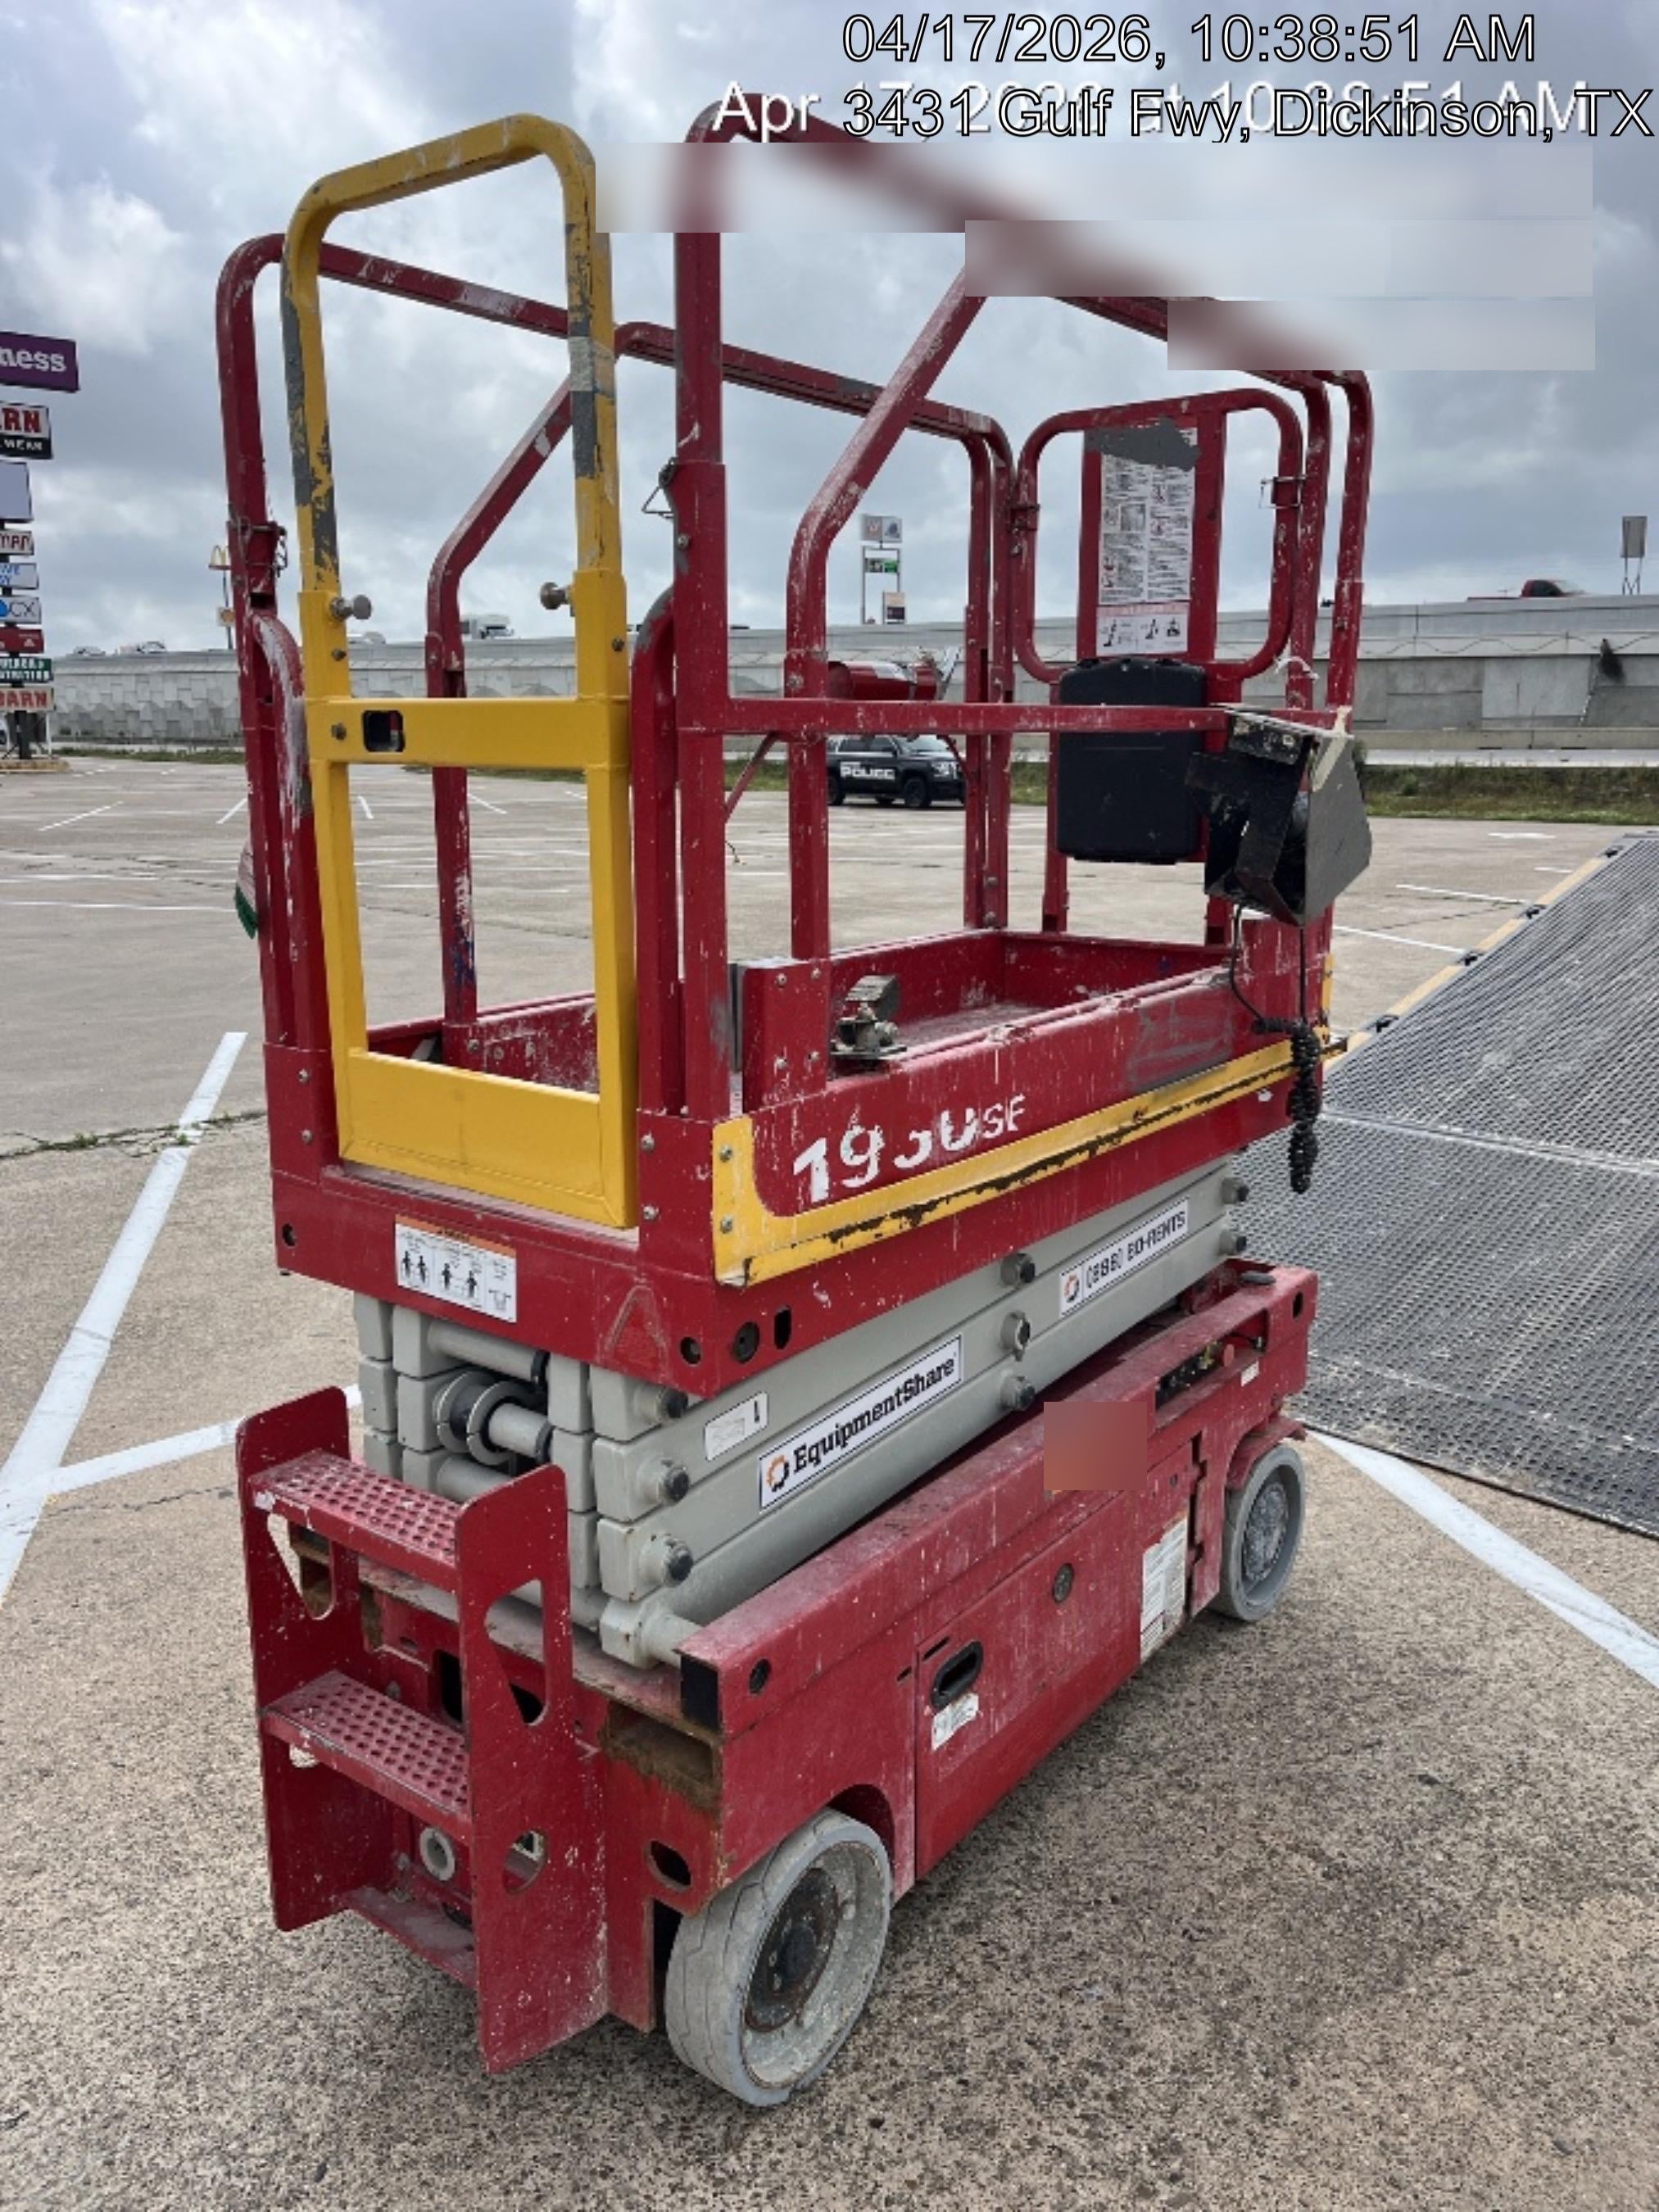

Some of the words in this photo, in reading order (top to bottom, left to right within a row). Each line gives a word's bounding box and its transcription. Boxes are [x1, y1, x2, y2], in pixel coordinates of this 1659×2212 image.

[0, 346, 66, 372] ness
[0, 408, 41, 433] RN
[792, 1357, 955, 1472] EquipmentShare
